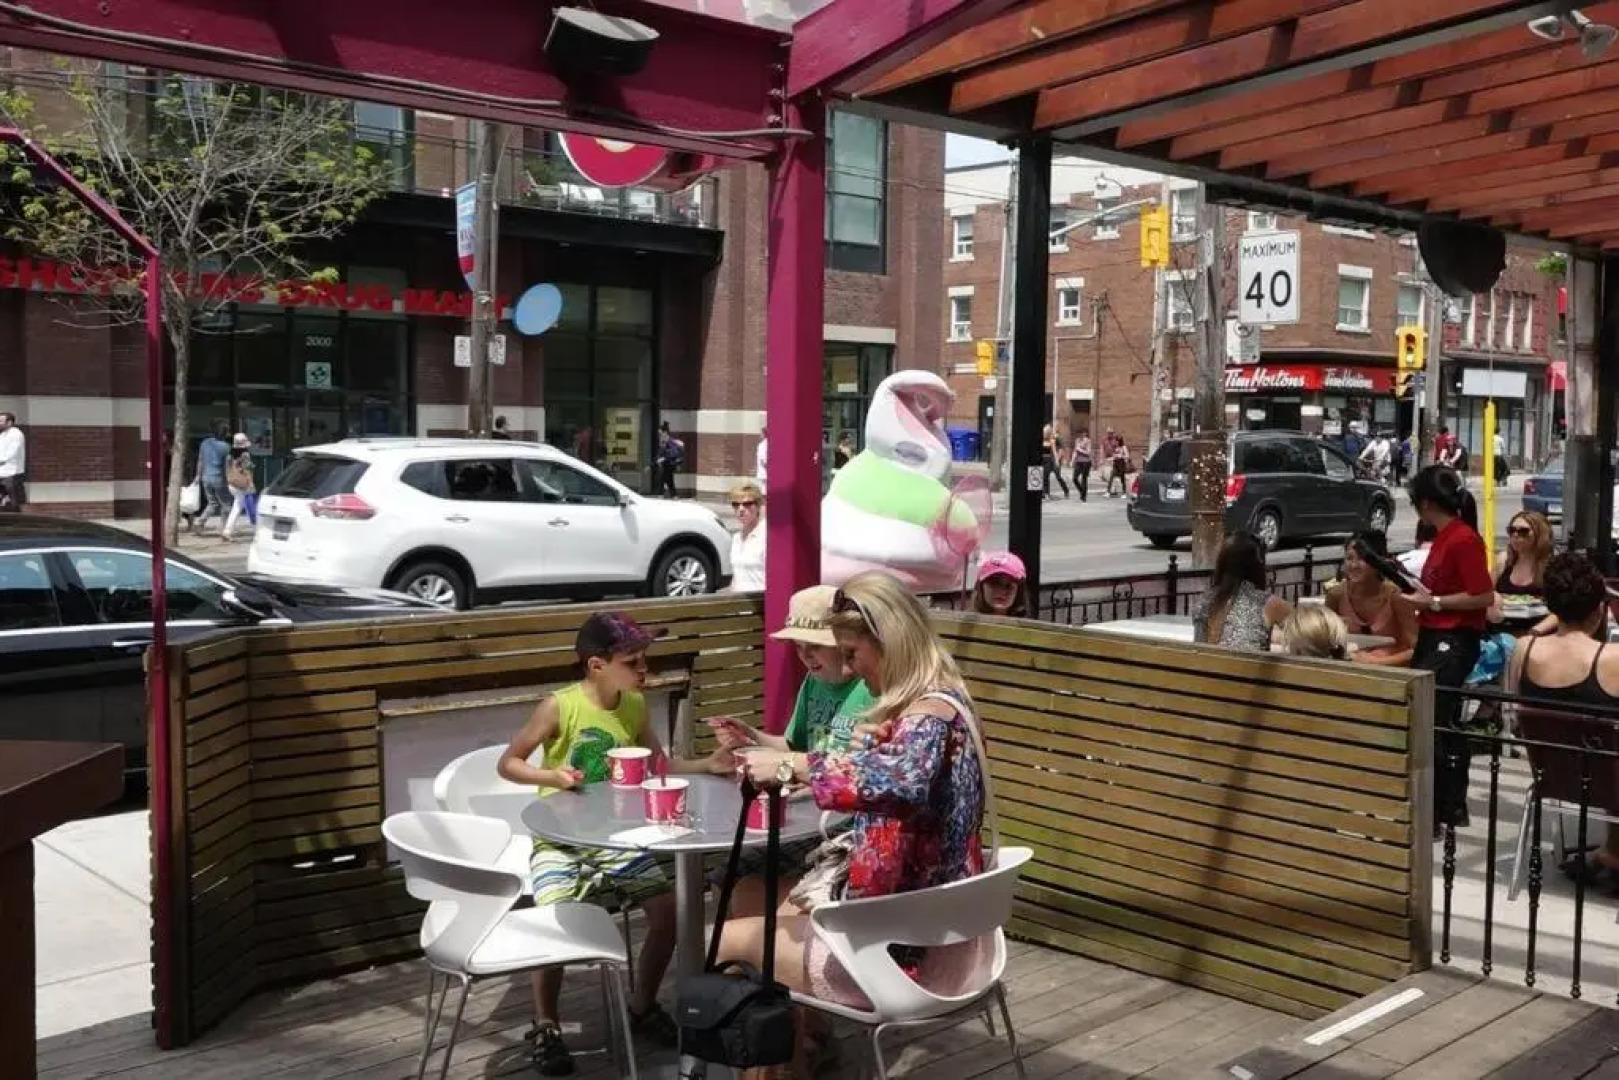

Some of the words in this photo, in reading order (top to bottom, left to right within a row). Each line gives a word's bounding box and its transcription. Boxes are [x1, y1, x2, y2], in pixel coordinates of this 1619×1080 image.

[1242, 241, 1296, 258] MAXIMUM
[278, 278, 394, 314] DRUG
[1245, 269, 1292, 308] 40
[305, 335, 332, 348] 2000
[1224, 367, 1250, 388] Tim
[1250, 366, 1306, 389] Hortons
